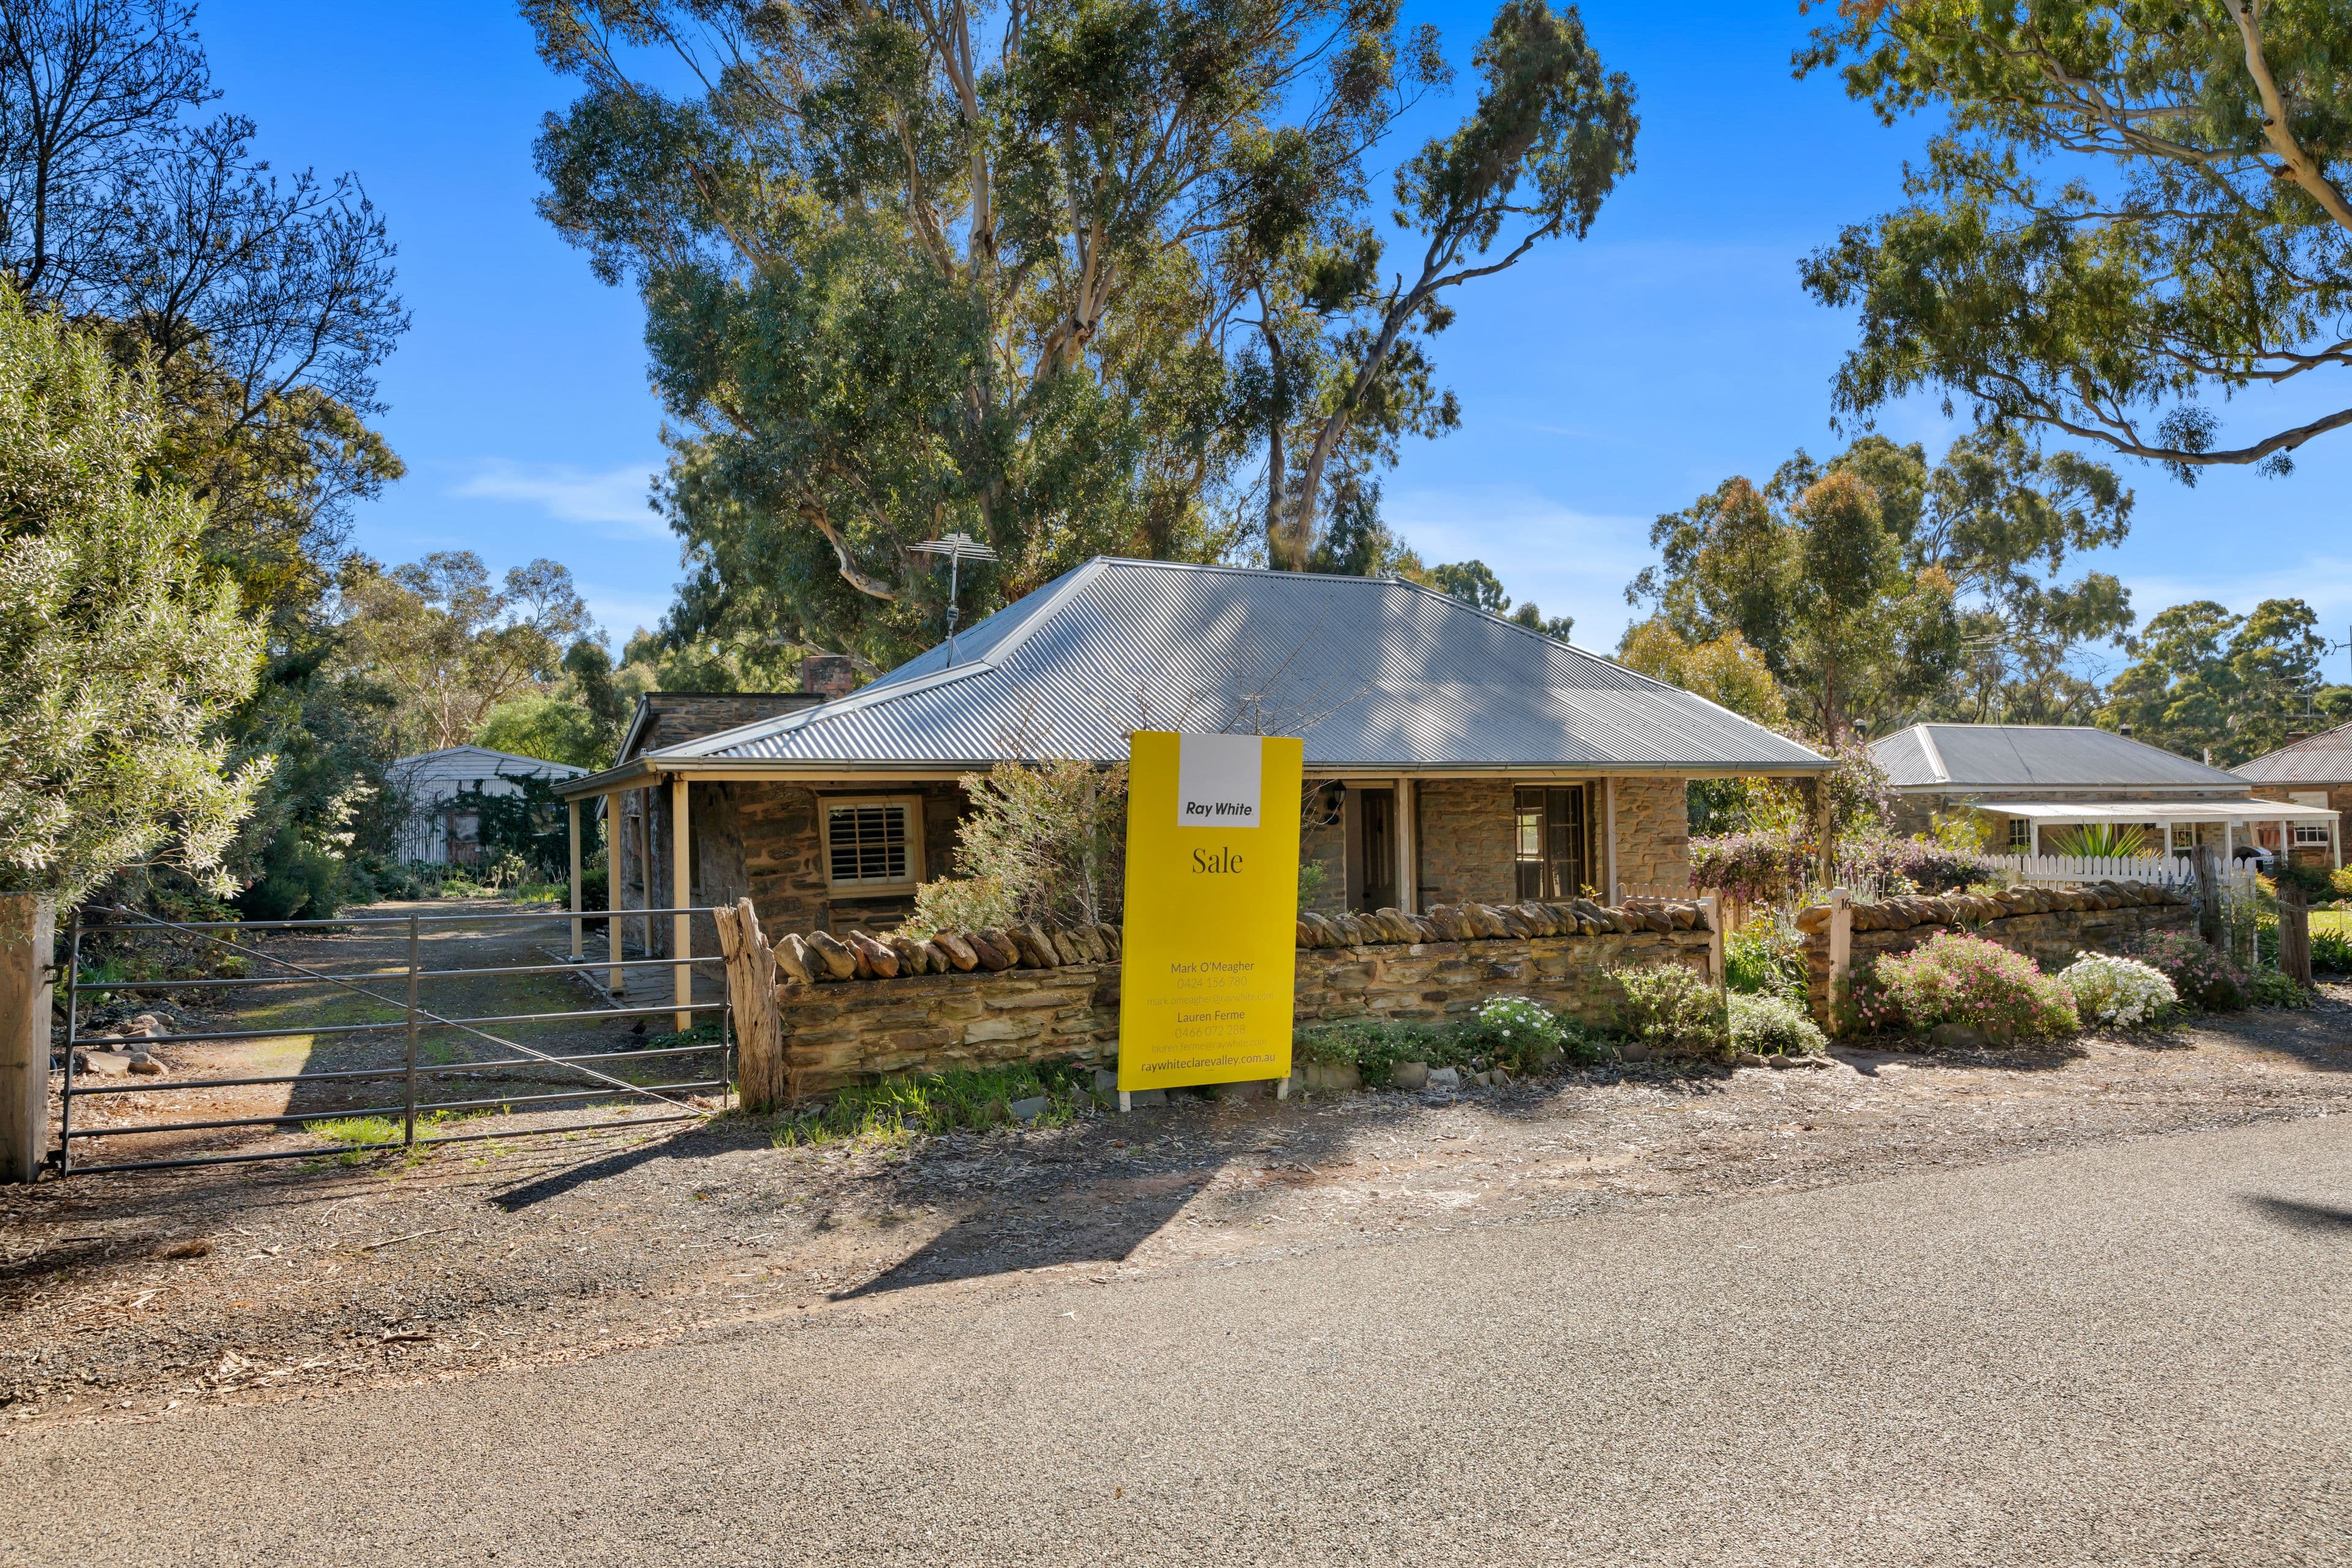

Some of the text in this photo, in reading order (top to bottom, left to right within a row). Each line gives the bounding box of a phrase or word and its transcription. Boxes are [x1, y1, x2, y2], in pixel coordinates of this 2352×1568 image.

[1186, 801, 1252, 817] Ray White
[1193, 846, 1243, 873] Sale
[1841, 897, 1851, 910] 16
[1171, 960, 1255, 974] Mark O'Meagher
[1177, 975, 1248, 989] 0424 156 780
[1147, 992, 1274, 1006] mark.omeagher@raywhite.com
[1177, 1010, 1245, 1023] Lauren Ferme
[1175, 1023, 1246, 1039] 0466 072 288
[1152, 1038, 1267, 1054] lauren.ferme@raywhite.com
[1141, 1054, 1275, 1073] raywhiteclarevalley.com.au
